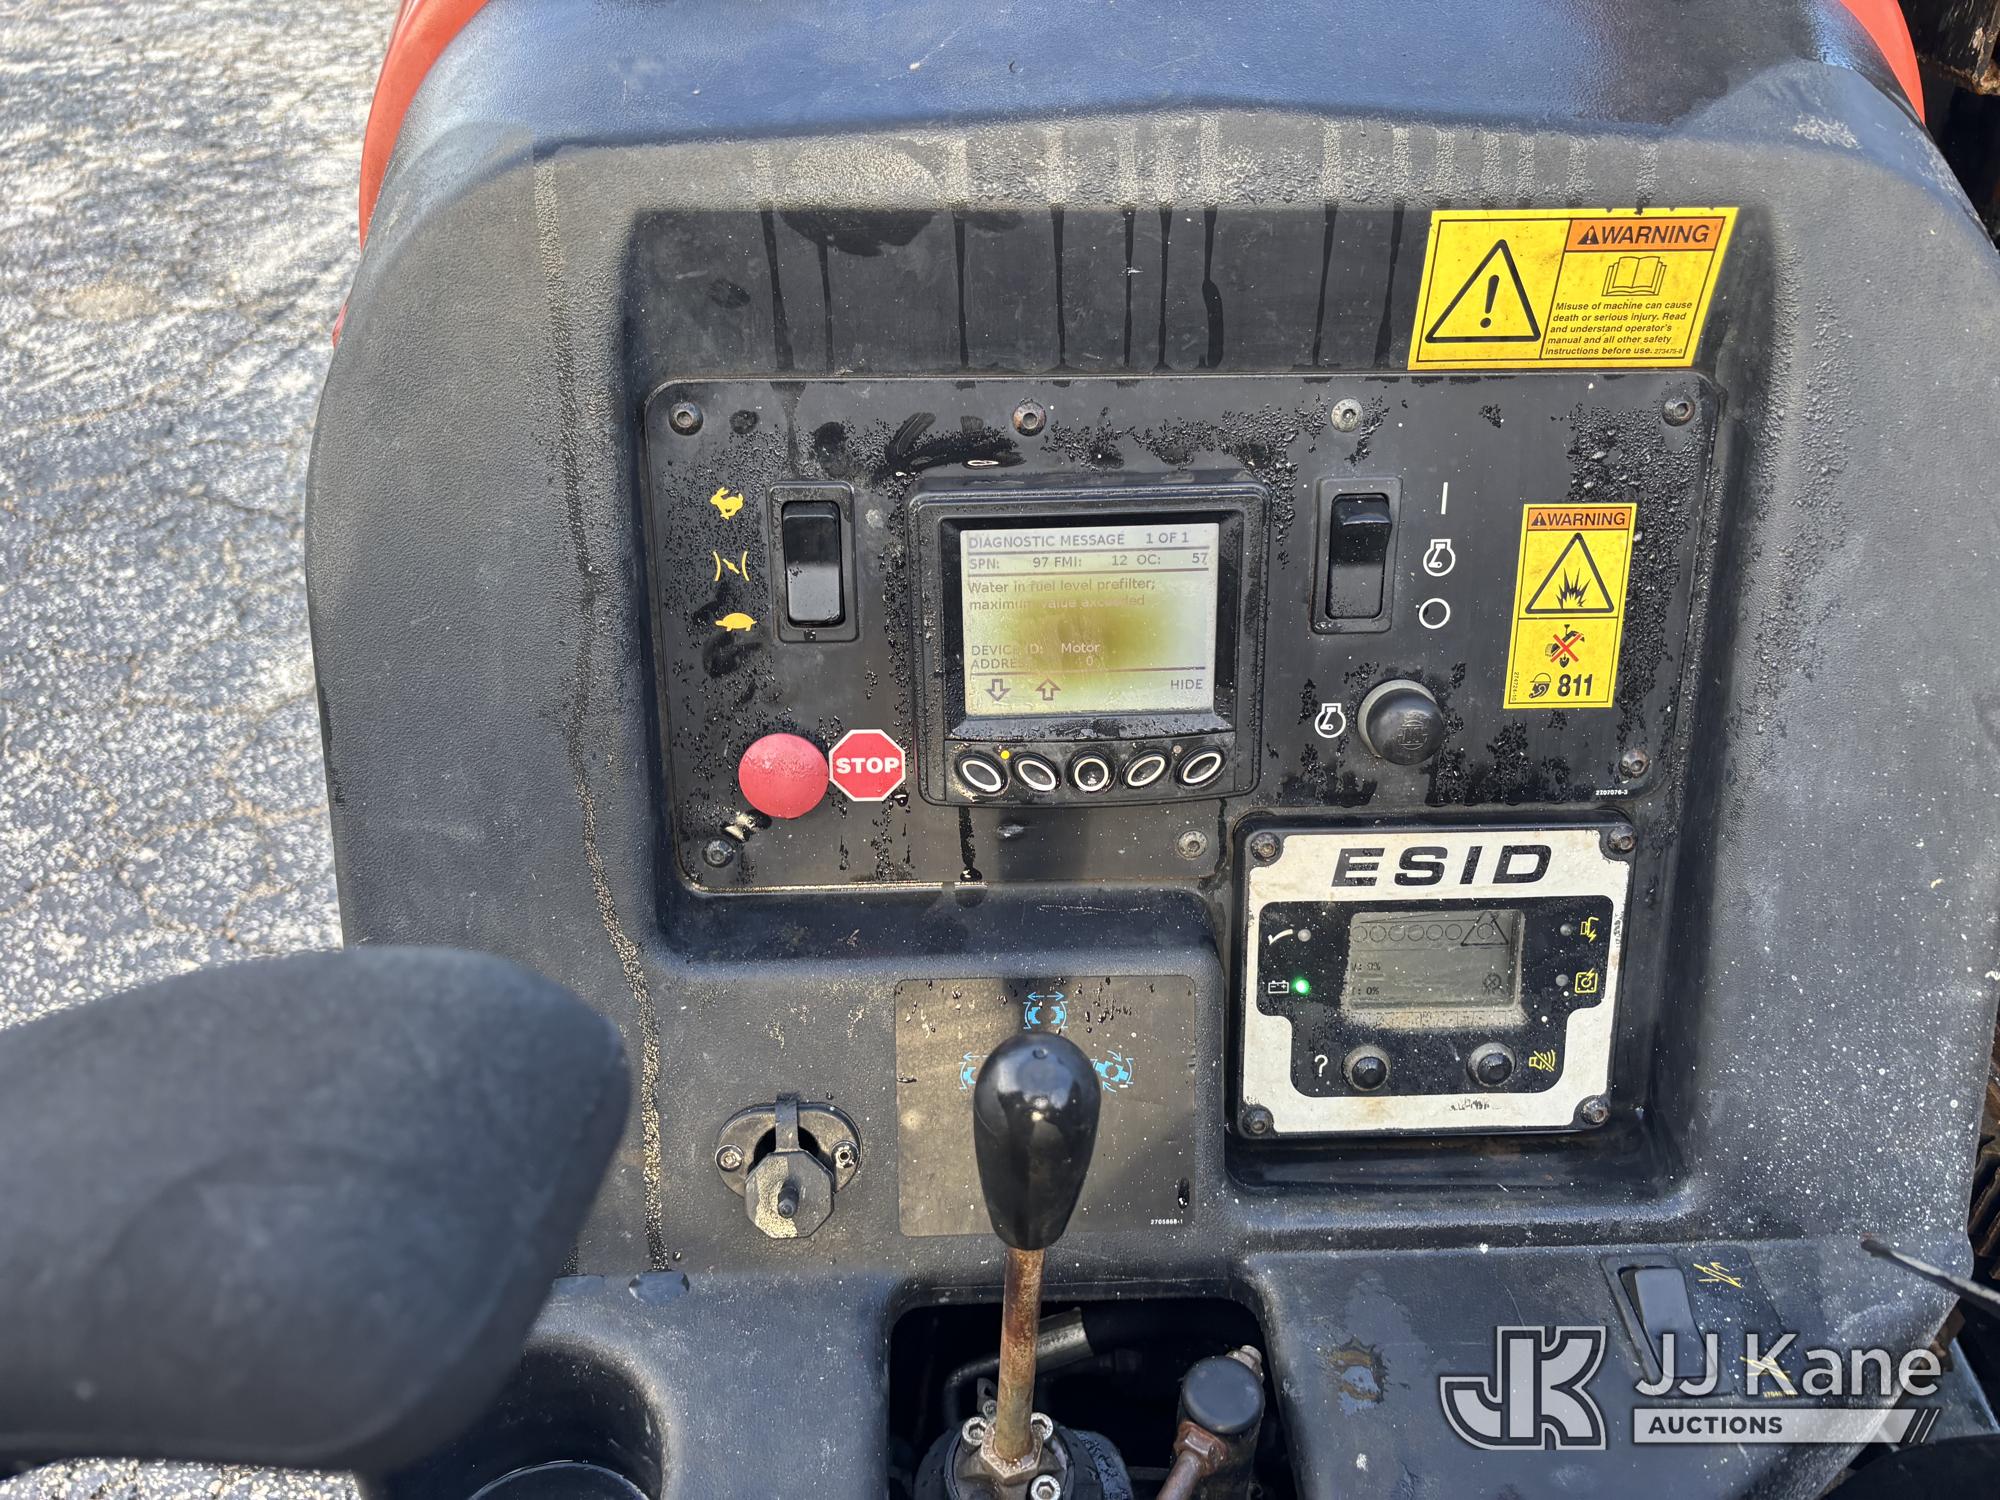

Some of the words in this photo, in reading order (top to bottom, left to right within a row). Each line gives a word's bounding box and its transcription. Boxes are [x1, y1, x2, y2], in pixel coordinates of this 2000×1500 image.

[1602, 224, 1710, 244] WARNING
[1555, 302, 1589, 310] Misuse
[1591, 302, 1602, 310] of
[1603, 302, 1643, 310] machine
[1553, 313, 1579, 321] death
[1594, 313, 1629, 321] serious
[1631, 312, 1660, 322] injury.
[1662, 312, 1687, 320] Read
[1570, 325, 1623, 333] understand
[1625, 324, 1673, 333] operator's
[1547, 336, 1582, 344] manual
[1583, 336, 1601, 344] and
[1643, 335, 1672, 344] safety
[1545, 347, 1599, 355] instructions
[1601, 346, 1632, 354] before
[1547, 512, 1626, 526] WARNING
[968, 536, 1056, 549] DIAGNOSTIC
[1060, 533, 1126, 546] MESSAGE
[1146, 532, 1154, 544] 1
[1158, 532, 1178, 543] OF
[1181, 532, 1190, 543] 1
[969, 558, 1000, 569] SPN:
[1032, 557, 1049, 568] 97
[1054, 556, 1082, 568] FMI:
[1111, 555, 1128, 566] 12
[1136, 554, 1161, 565] OC:
[1192, 552, 1208, 564] 57
[968, 582, 1009, 593] Water
[1014, 580, 1026, 592] in
[1030, 580, 1056, 591] fuel
[1060, 578, 1092, 591] level
[1097, 577, 1155, 592] prefilter;
[1061, 642, 1101, 654] Motor
[1170, 679, 1203, 690] HIDE
[1557, 673, 1593, 697] 811
[836, 757, 900, 774] STOP
[1331, 844, 1552, 888] ESID
[1366, 986, 1380, 996] 0%
